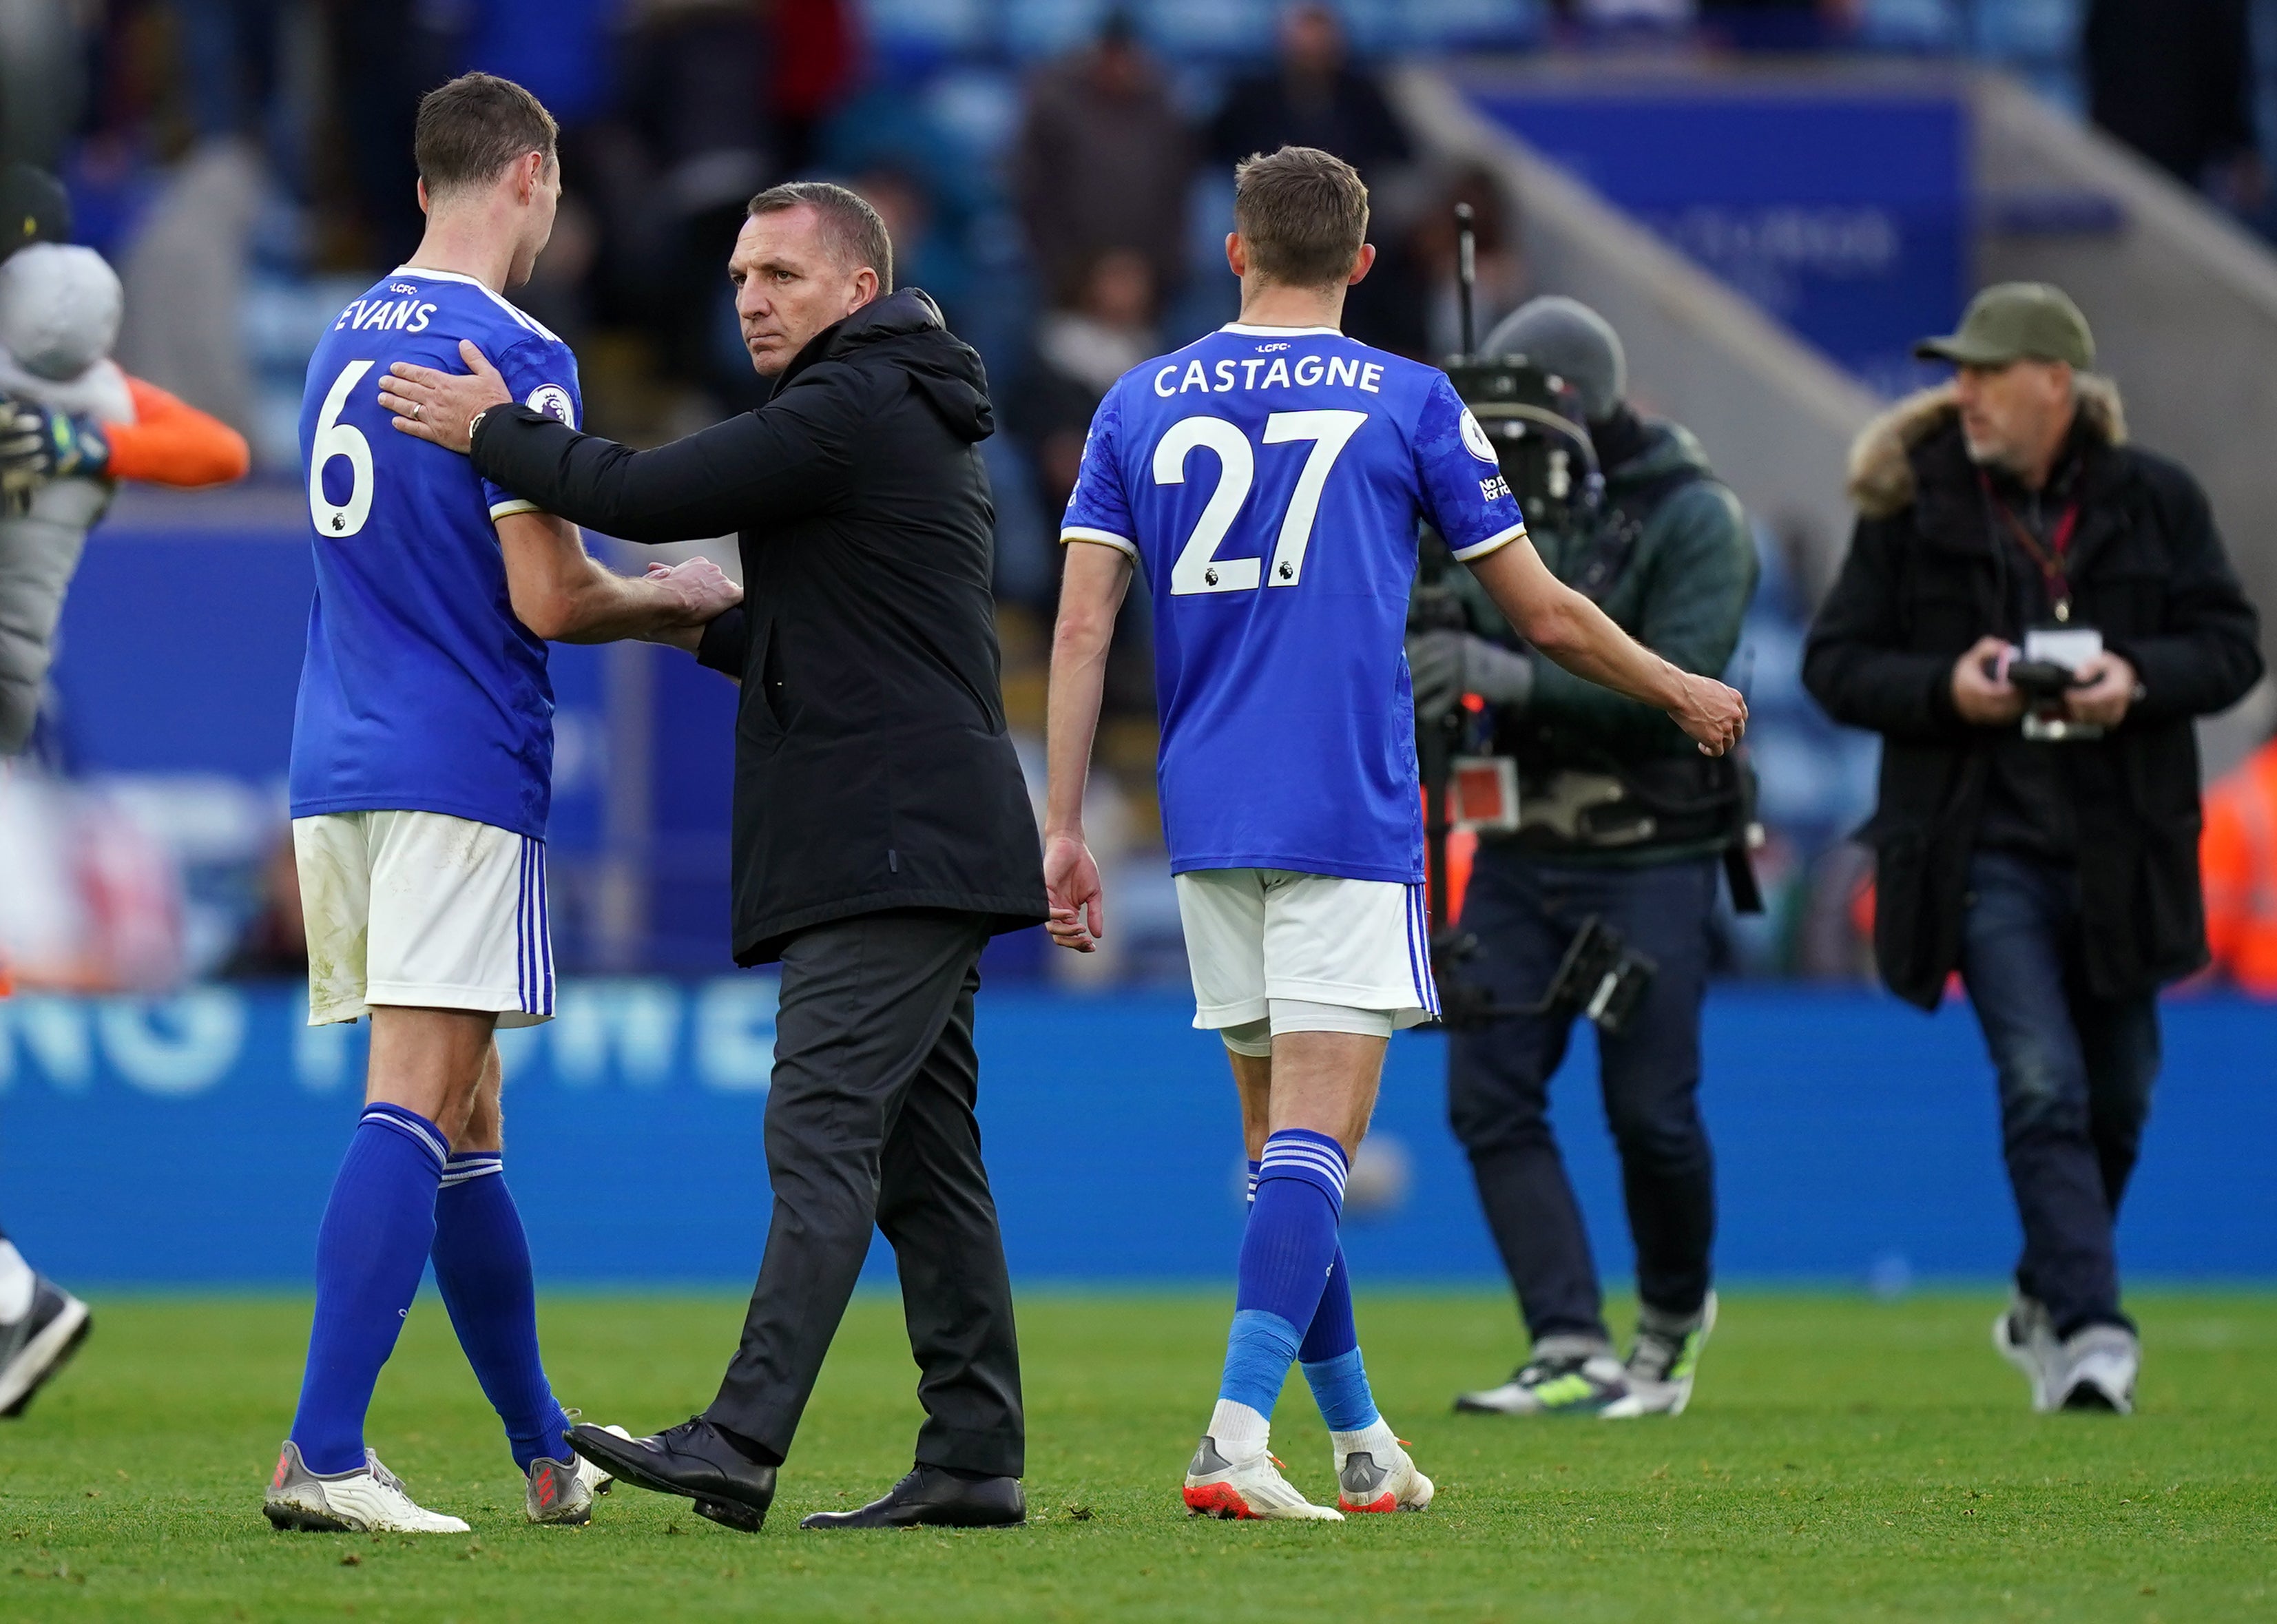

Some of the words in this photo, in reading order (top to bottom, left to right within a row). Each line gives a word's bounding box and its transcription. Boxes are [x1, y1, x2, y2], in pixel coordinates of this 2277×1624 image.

[334, 300, 437, 332] EVANS
[1154, 356, 1384, 397] CASTAGNE
[309, 360, 372, 538] 6
[1479, 478, 1497, 490] No
[1483, 488, 1499, 501] for
[1152, 409, 1369, 596] 27
